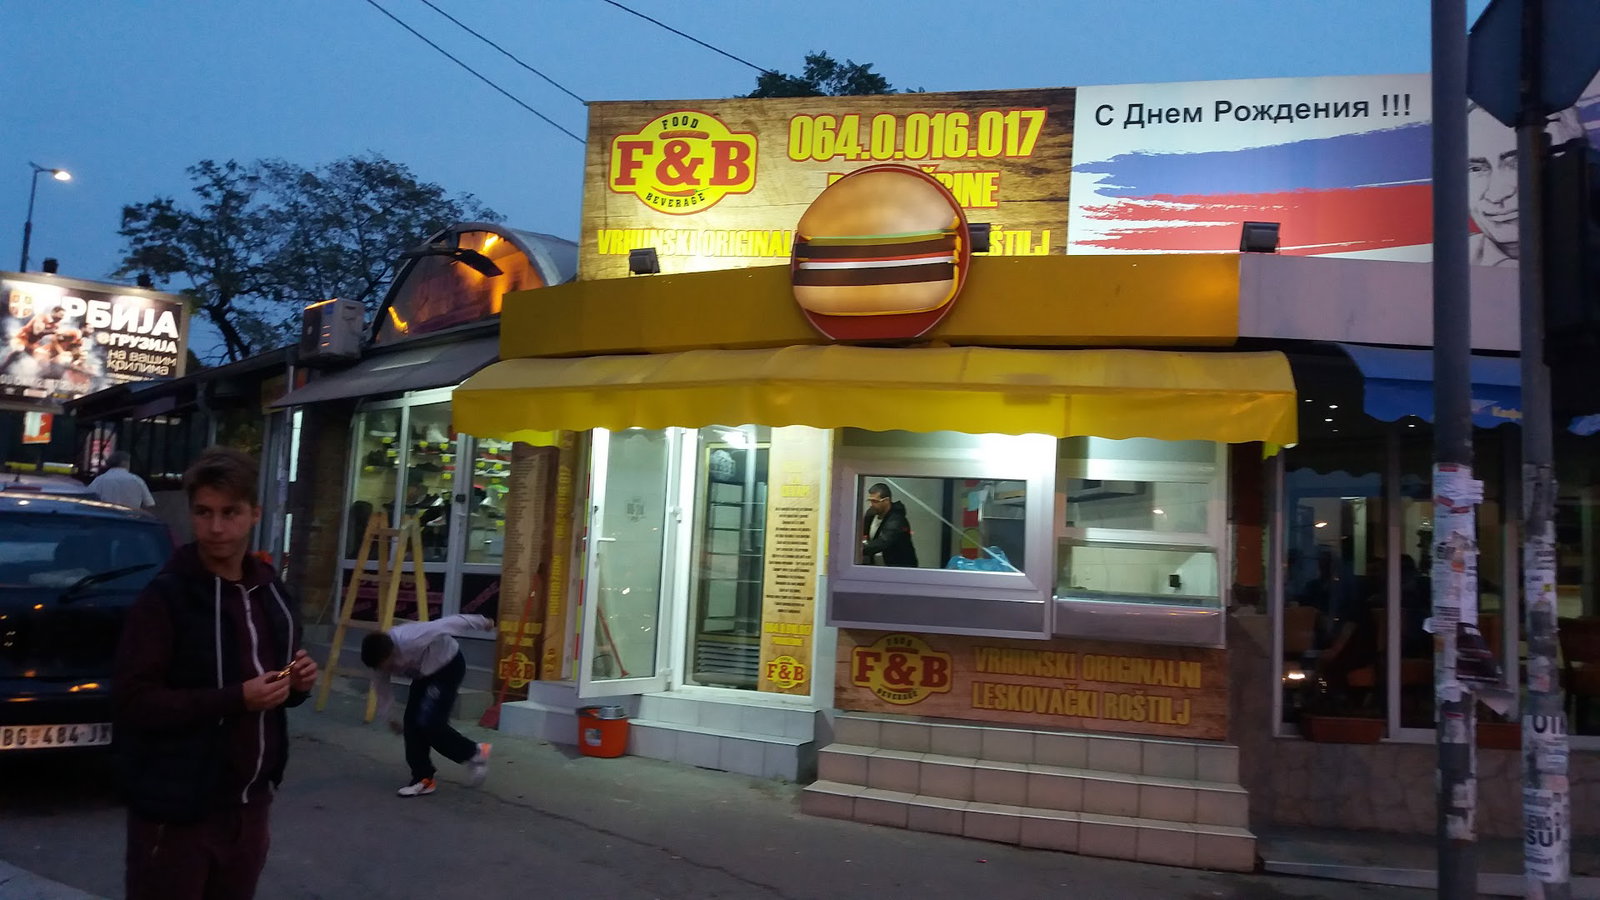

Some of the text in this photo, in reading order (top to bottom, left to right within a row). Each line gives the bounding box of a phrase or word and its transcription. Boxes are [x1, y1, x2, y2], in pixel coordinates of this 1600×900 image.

[661, 115, 700, 130] FOOD
[1095, 104, 1115, 126] С
[1123, 102, 1203, 130] Днем
[1214, 99, 1370, 125] Рождения
[788, 108, 1047, 162] 064.0.016.017
[614, 139, 751, 186] F&B
[645, 192, 706, 208] BEVERAGE
[703, 229, 793, 258] ORIGINAL
[971, 224, 1051, 257] ŠTILJ
[58, 295, 179, 339] РБИЈА
[766, 663, 804, 681] F&B
[854, 651, 948, 688] F&B
[974, 647, 1202, 689] VRHUNSKI ORIGINALNI
[971, 681, 1192, 726] LESKOVAČKI ROŠTILJ
